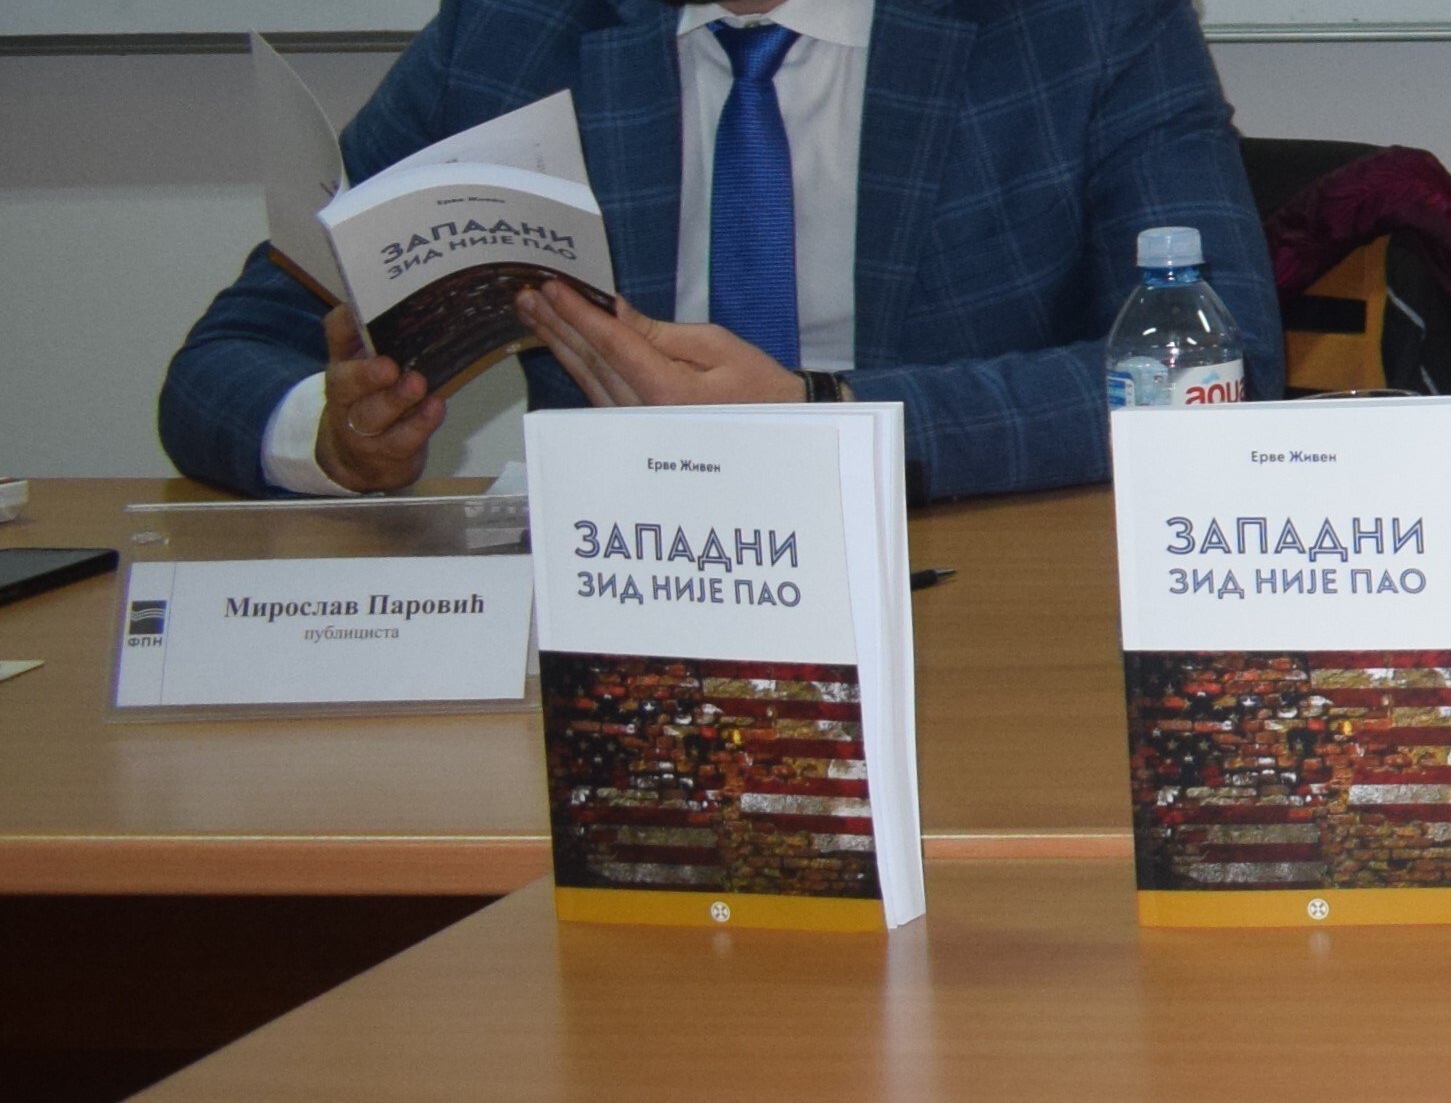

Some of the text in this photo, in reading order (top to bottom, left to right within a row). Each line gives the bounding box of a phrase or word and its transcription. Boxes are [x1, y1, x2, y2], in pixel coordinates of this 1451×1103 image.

[380, 218, 576, 264] ЗАПАДНИ
[387, 236, 578, 280] ЗИД НИЈЕ ПАО
[647, 457, 721, 474] Ерве Живен
[1250, 450, 1337, 465] Ерве Живен
[573, 519, 799, 572] ЗАПАДНИ
[1165, 516, 1425, 562] ЗАПАДНИ
[576, 570, 802, 609] ЗИД НИЈЕ ПАО
[1168, 567, 1427, 599] ЗИД НИЈЕ ПАО
[224, 592, 485, 622] Мирослав Паровић
[127, 636, 163, 648] ФПН
[303, 624, 400, 642] публициста
